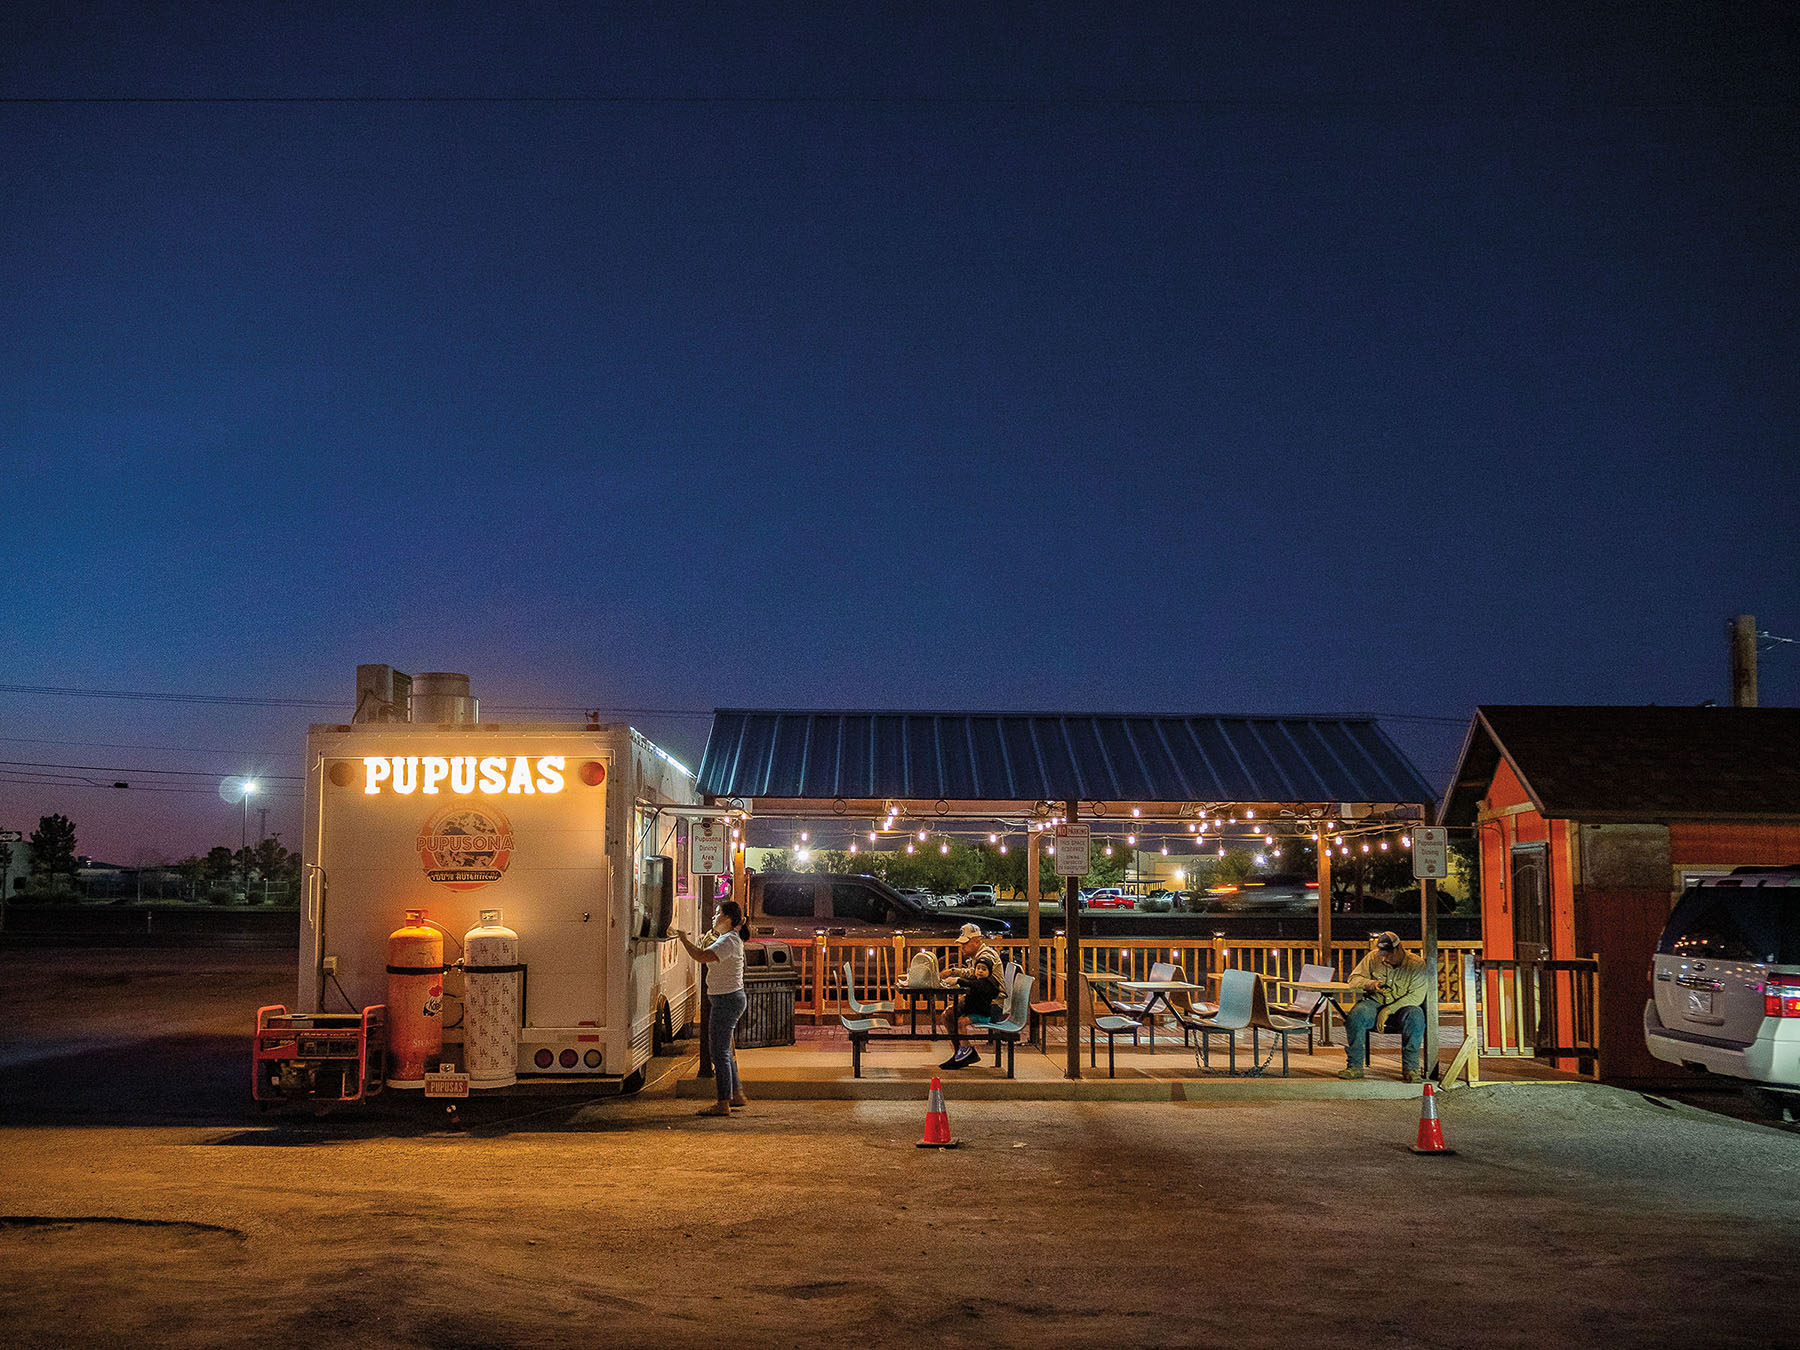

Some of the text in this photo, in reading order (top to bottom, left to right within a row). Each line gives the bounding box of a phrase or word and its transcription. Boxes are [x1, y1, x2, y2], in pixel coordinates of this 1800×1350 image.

[363, 756, 566, 794] PUPUSAS
[1057, 826, 1067, 836] NO
[416, 835, 515, 851] PUPUSONA
[699, 845, 718, 853] Dining
[430, 1081, 464, 1093] PUPUSAS
